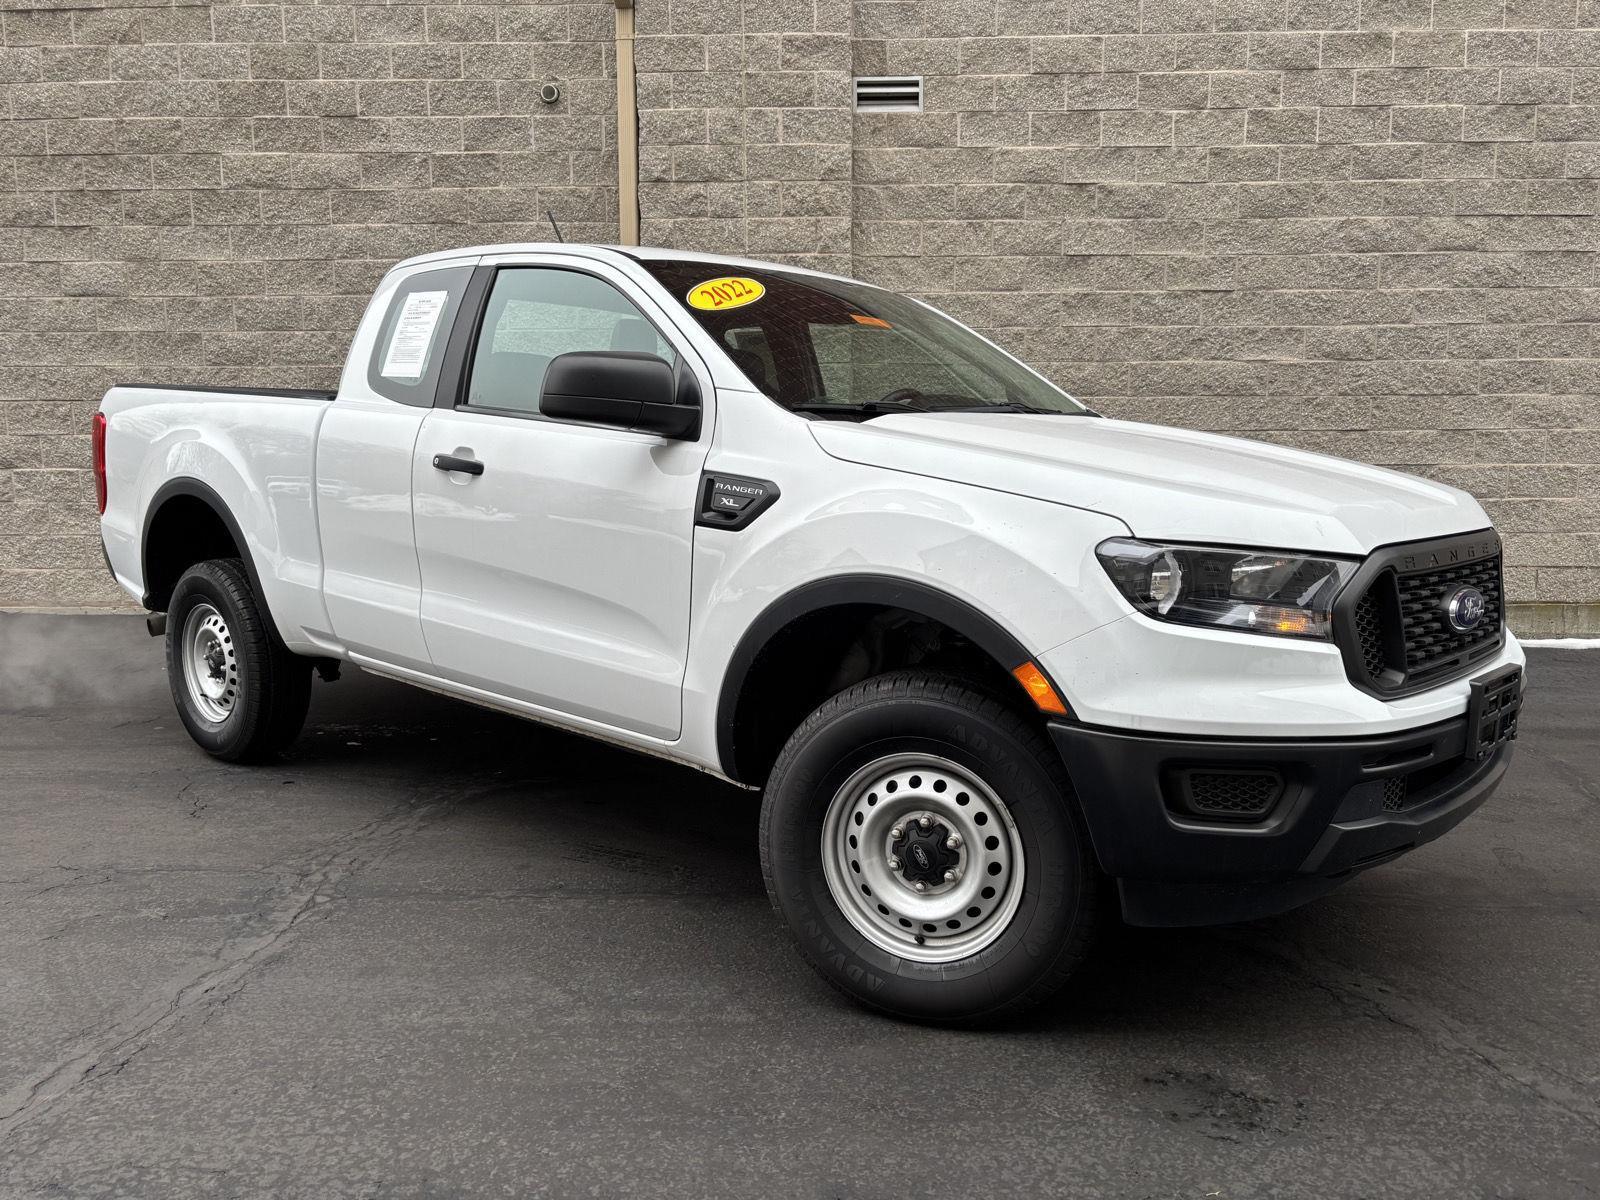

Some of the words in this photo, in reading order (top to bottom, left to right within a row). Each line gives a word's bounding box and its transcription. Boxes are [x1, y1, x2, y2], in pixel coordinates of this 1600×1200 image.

[701, 280, 753, 306] 2022
[715, 482, 763, 495] RANGER
[720, 497, 740, 507] XL
[1405, 540, 1499, 569] RANGER
